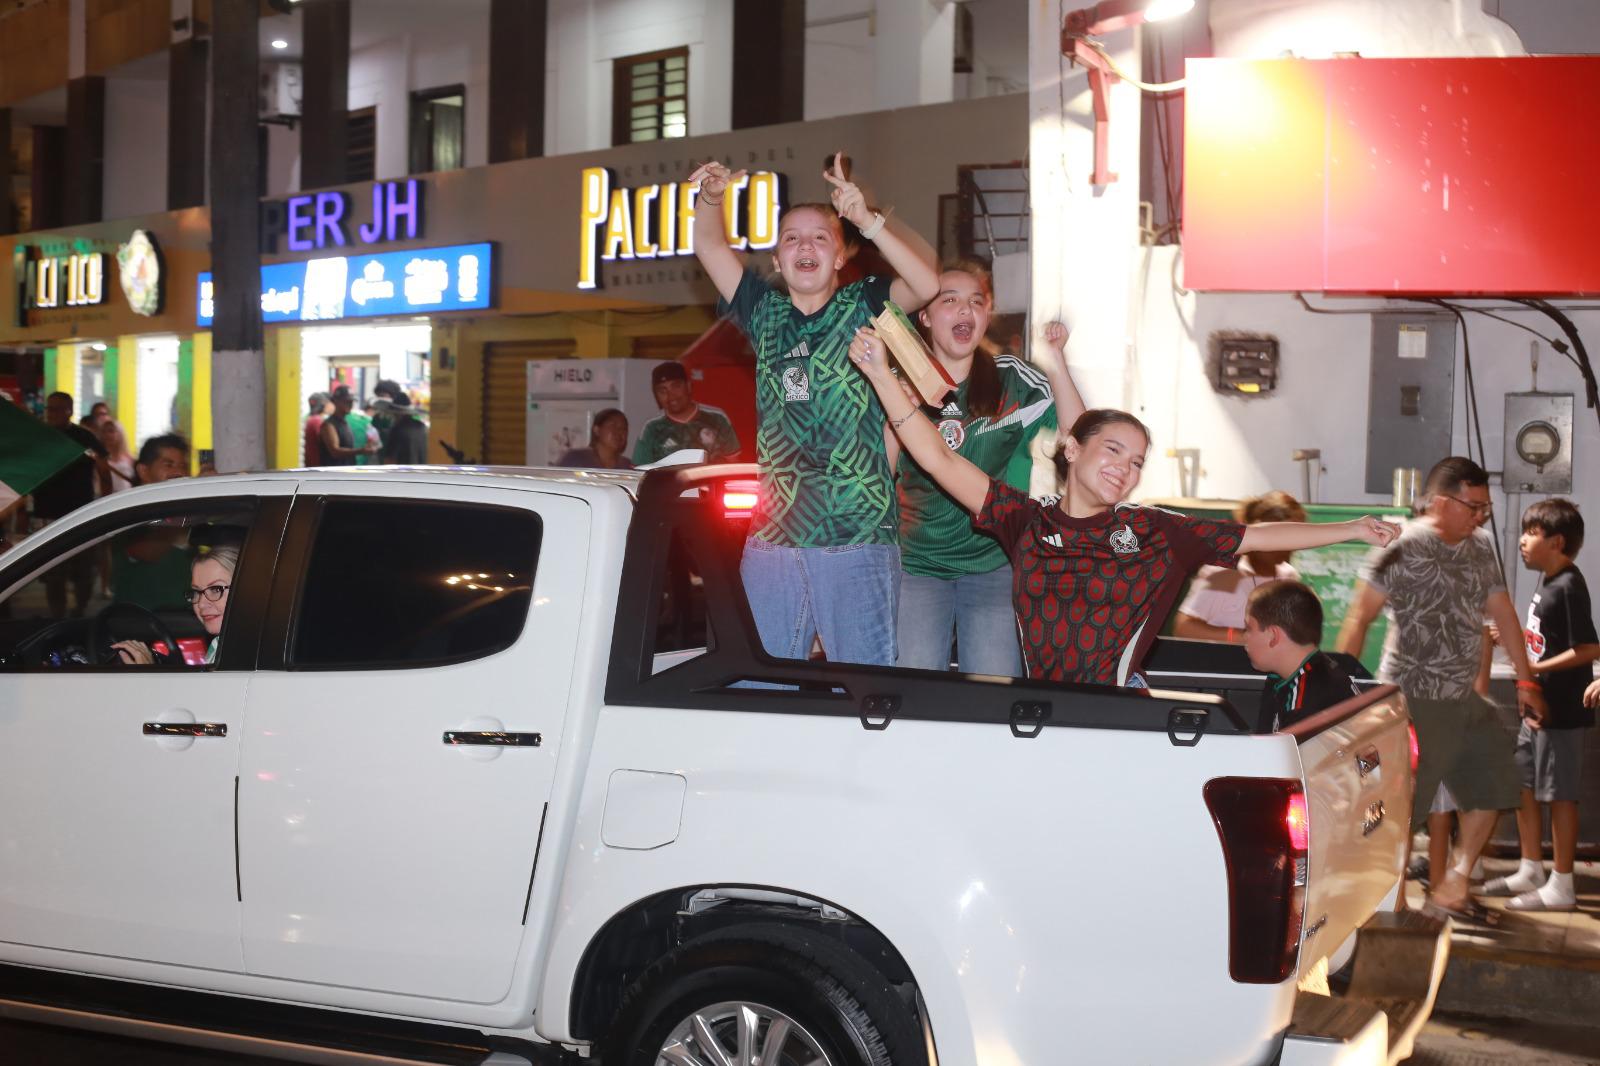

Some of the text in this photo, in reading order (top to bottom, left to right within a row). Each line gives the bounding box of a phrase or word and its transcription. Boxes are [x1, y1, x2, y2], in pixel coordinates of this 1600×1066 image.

[261, 178, 418, 252] PER JH
[577, 167, 780, 288] PACIFCO
[554, 368, 593, 383] HIELO
